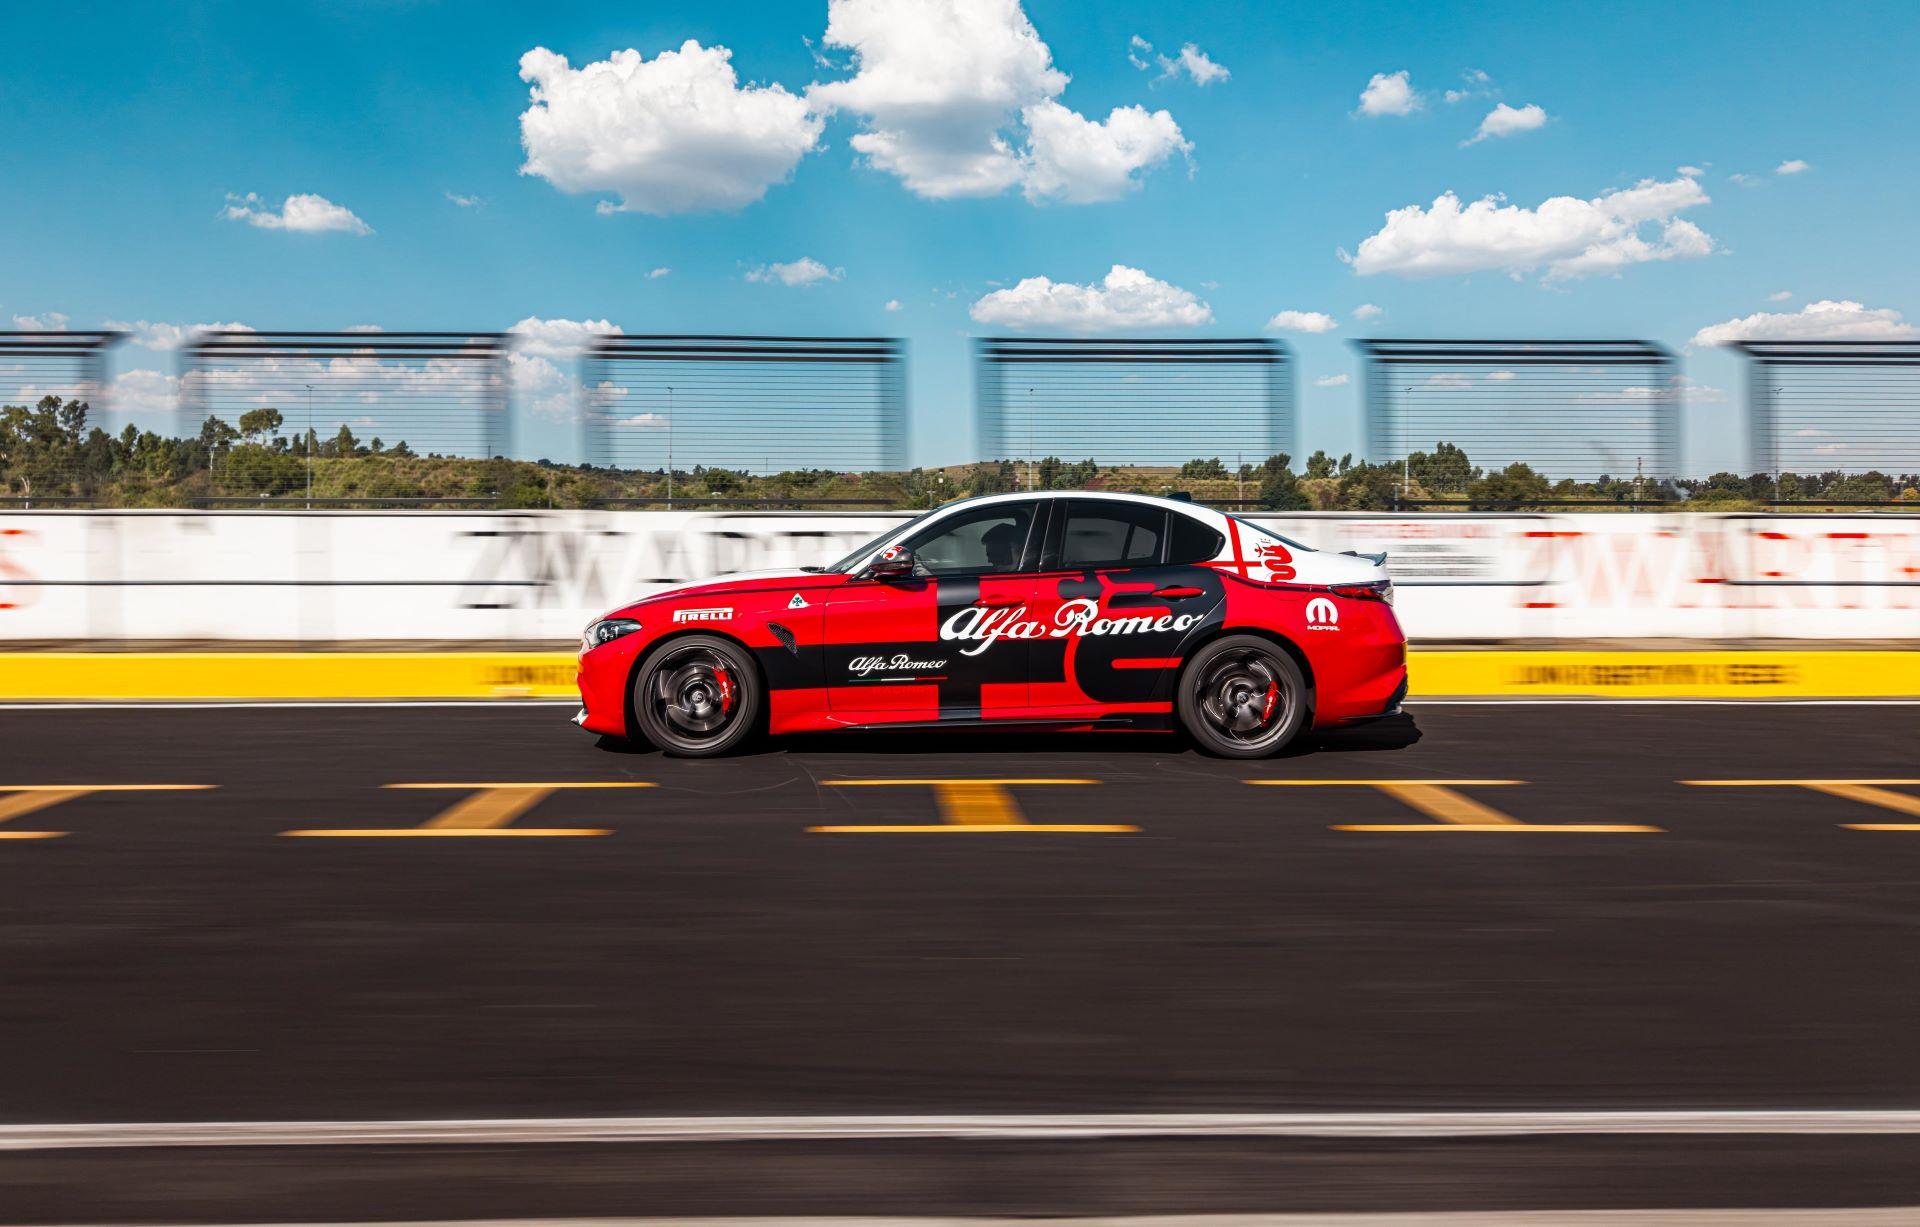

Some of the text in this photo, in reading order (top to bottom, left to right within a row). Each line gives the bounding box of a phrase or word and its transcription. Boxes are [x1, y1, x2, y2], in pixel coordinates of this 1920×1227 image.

[673, 607, 734, 624] PIRELLI
[939, 598, 1204, 657] Alfa Romeo
[848, 653, 948, 677] Alfa Romeo
